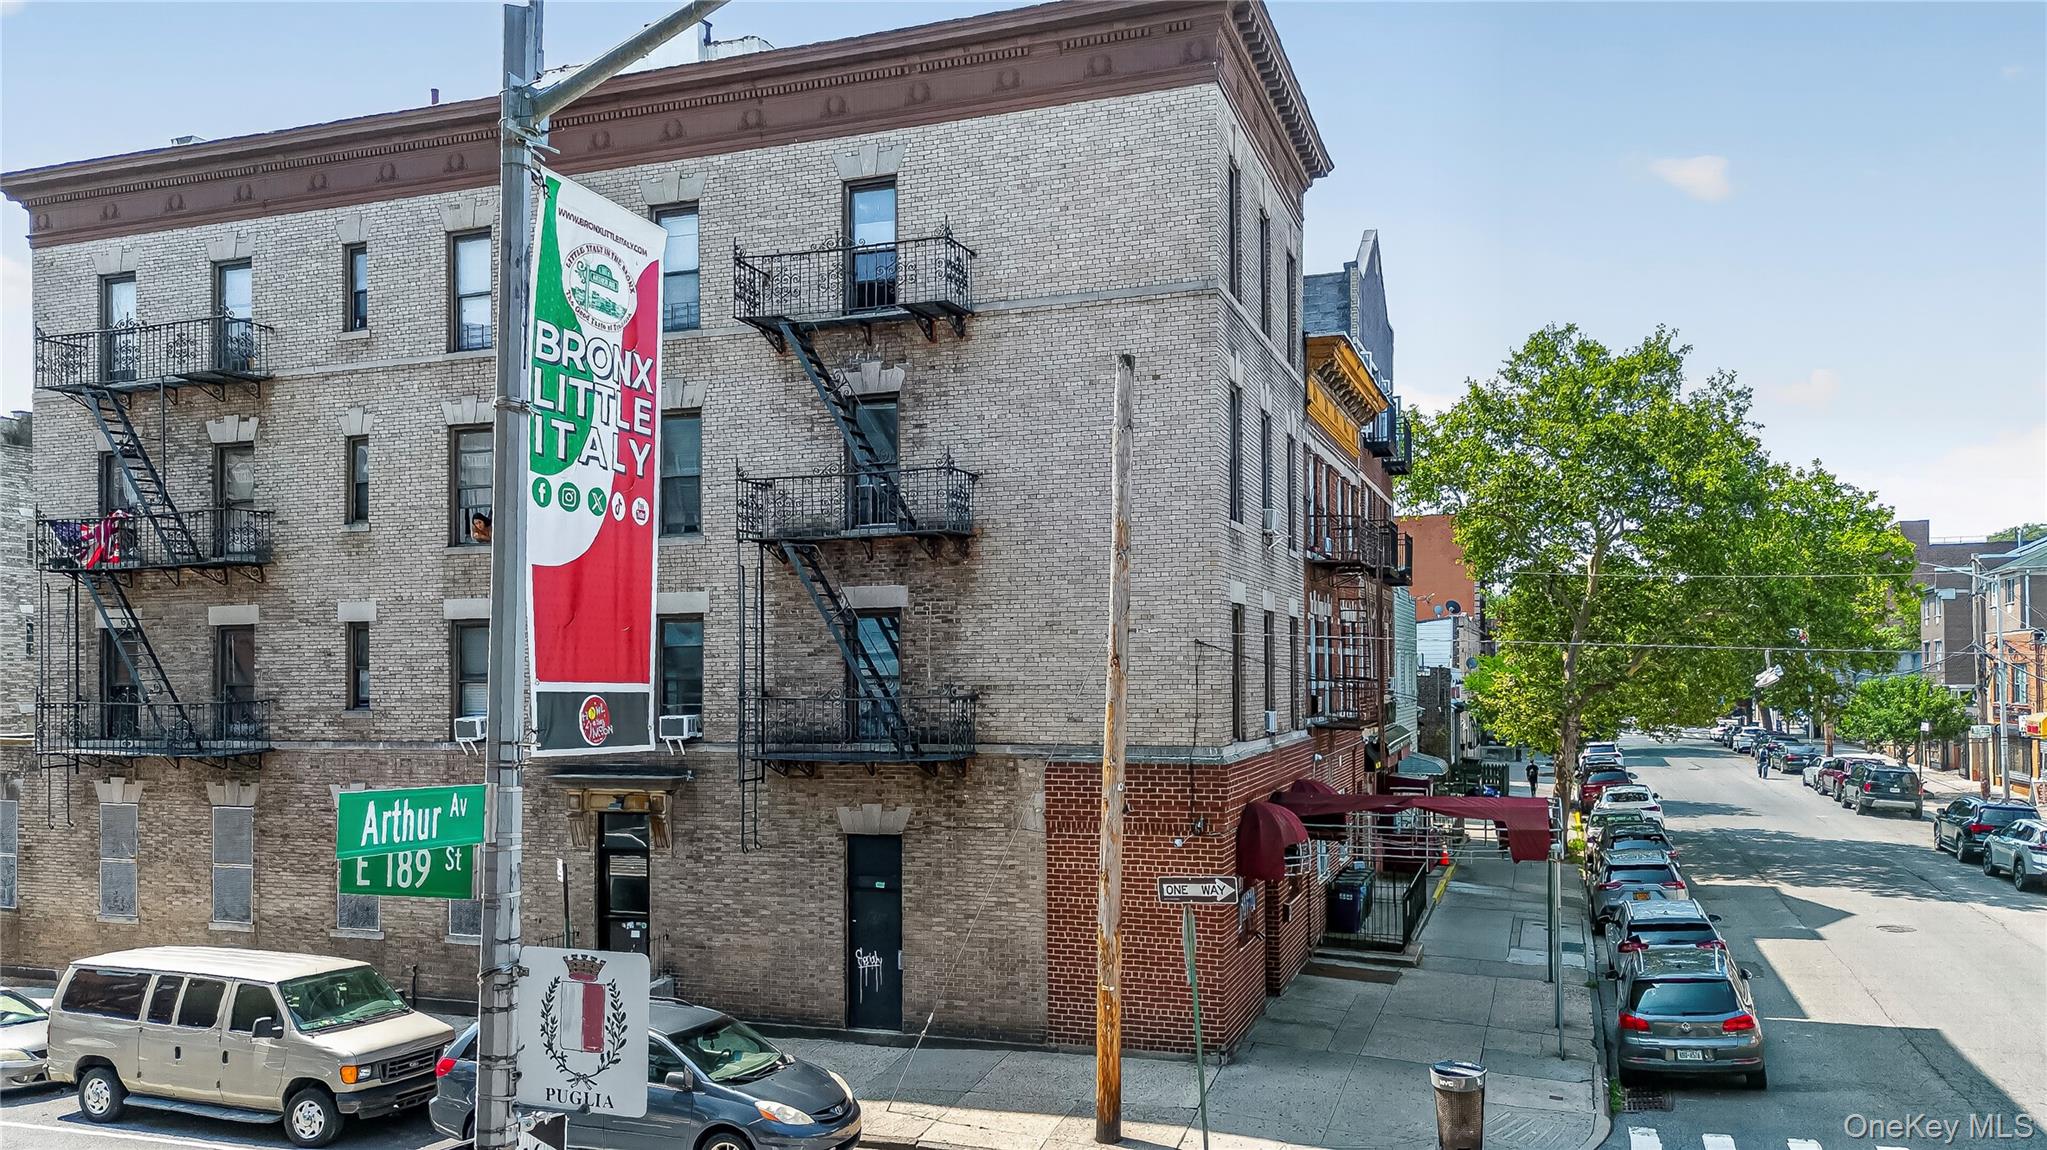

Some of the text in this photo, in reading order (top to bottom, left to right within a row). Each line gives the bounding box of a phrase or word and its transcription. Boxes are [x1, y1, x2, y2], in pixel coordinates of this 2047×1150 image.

[558, 207, 648, 257] WWW.BRONXLITTLEITALY.COM
[565, 246, 586, 269] LITTLE
[585, 244, 603, 254] ITALY
[604, 247, 611, 256] IN
[611, 252, 623, 266] THE
[574, 306, 590, 321] Good
[535, 320, 654, 394] BRONX
[533, 367, 652, 437] LITTLE
[534, 413, 652, 477] ITALY
[360, 792, 468, 847] Arthur Av
[356, 846, 462, 889] E 189 St
[1166, 885, 1226, 895] ONE WAY
[545, 1087, 615, 1110] PUGLIA
